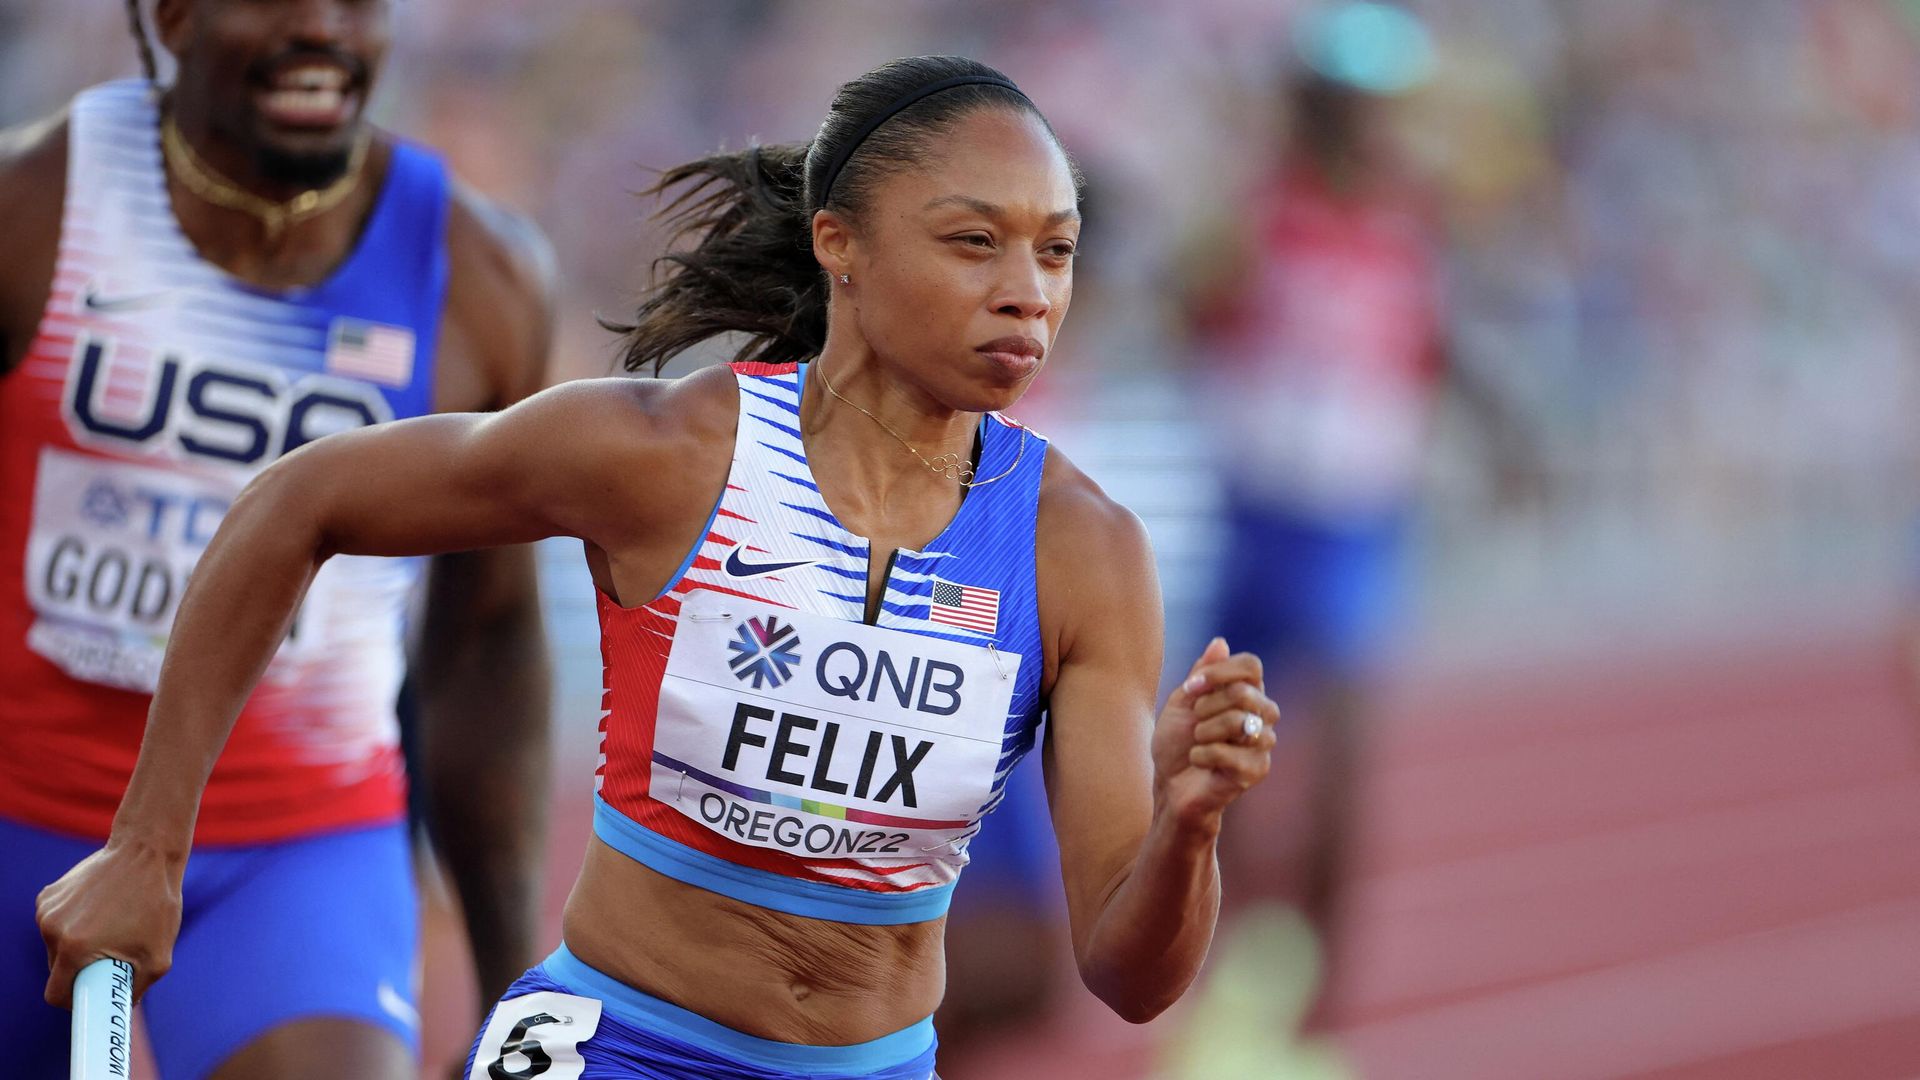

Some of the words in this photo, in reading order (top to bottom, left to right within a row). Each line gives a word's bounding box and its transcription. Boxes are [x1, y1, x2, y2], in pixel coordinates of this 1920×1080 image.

[815, 641, 965, 716] QNB
[721, 702, 934, 809] FELIX
[700, 792, 910, 855] OREGON22
[109, 1015, 127, 1078] WORLD
[487, 1012, 561, 1080] 6
